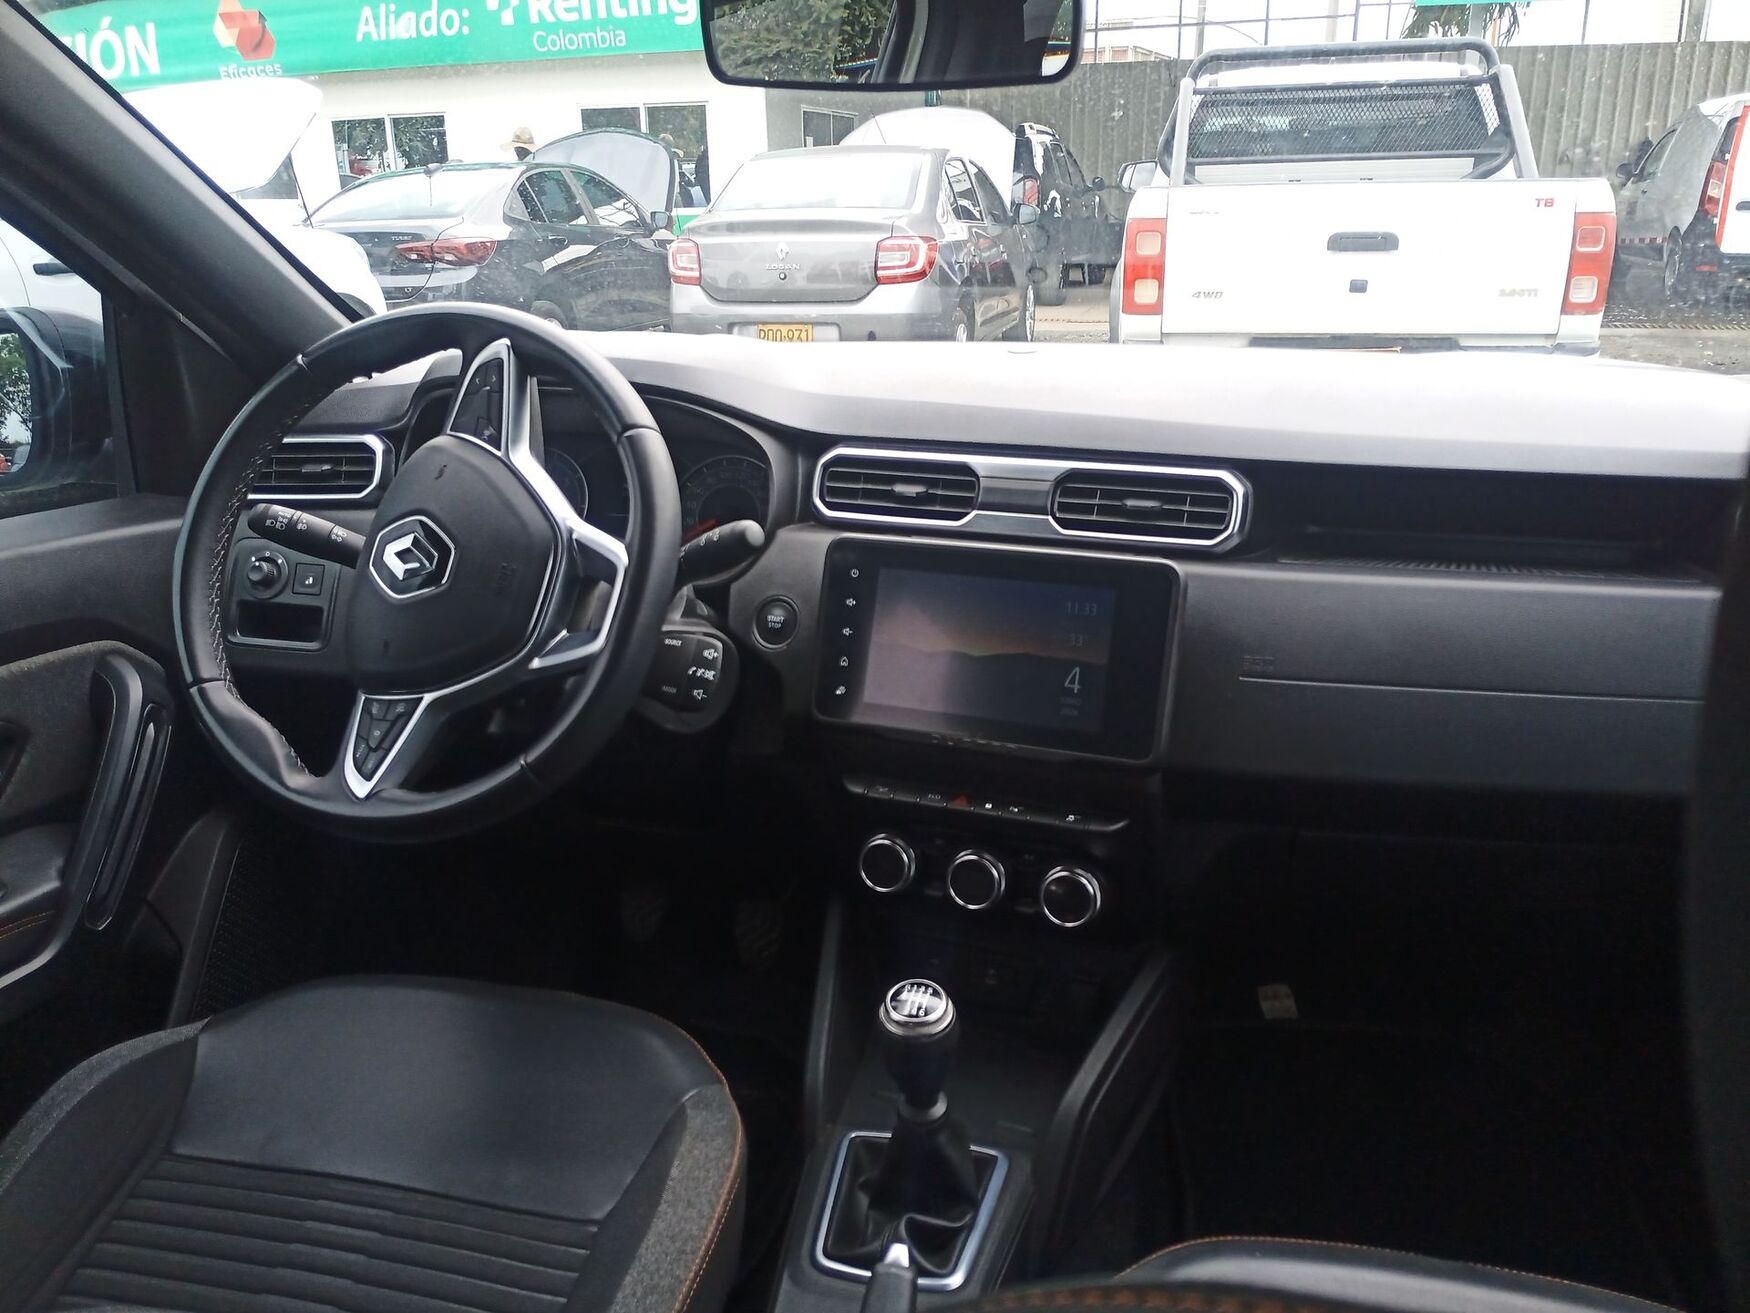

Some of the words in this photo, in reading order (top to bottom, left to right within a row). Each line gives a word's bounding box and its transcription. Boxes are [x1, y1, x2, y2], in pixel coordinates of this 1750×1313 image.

[356, 0, 470, 42] Aliado:
[532, 26, 627, 52] Colombia
[1064, 666, 1081, 694] 4
